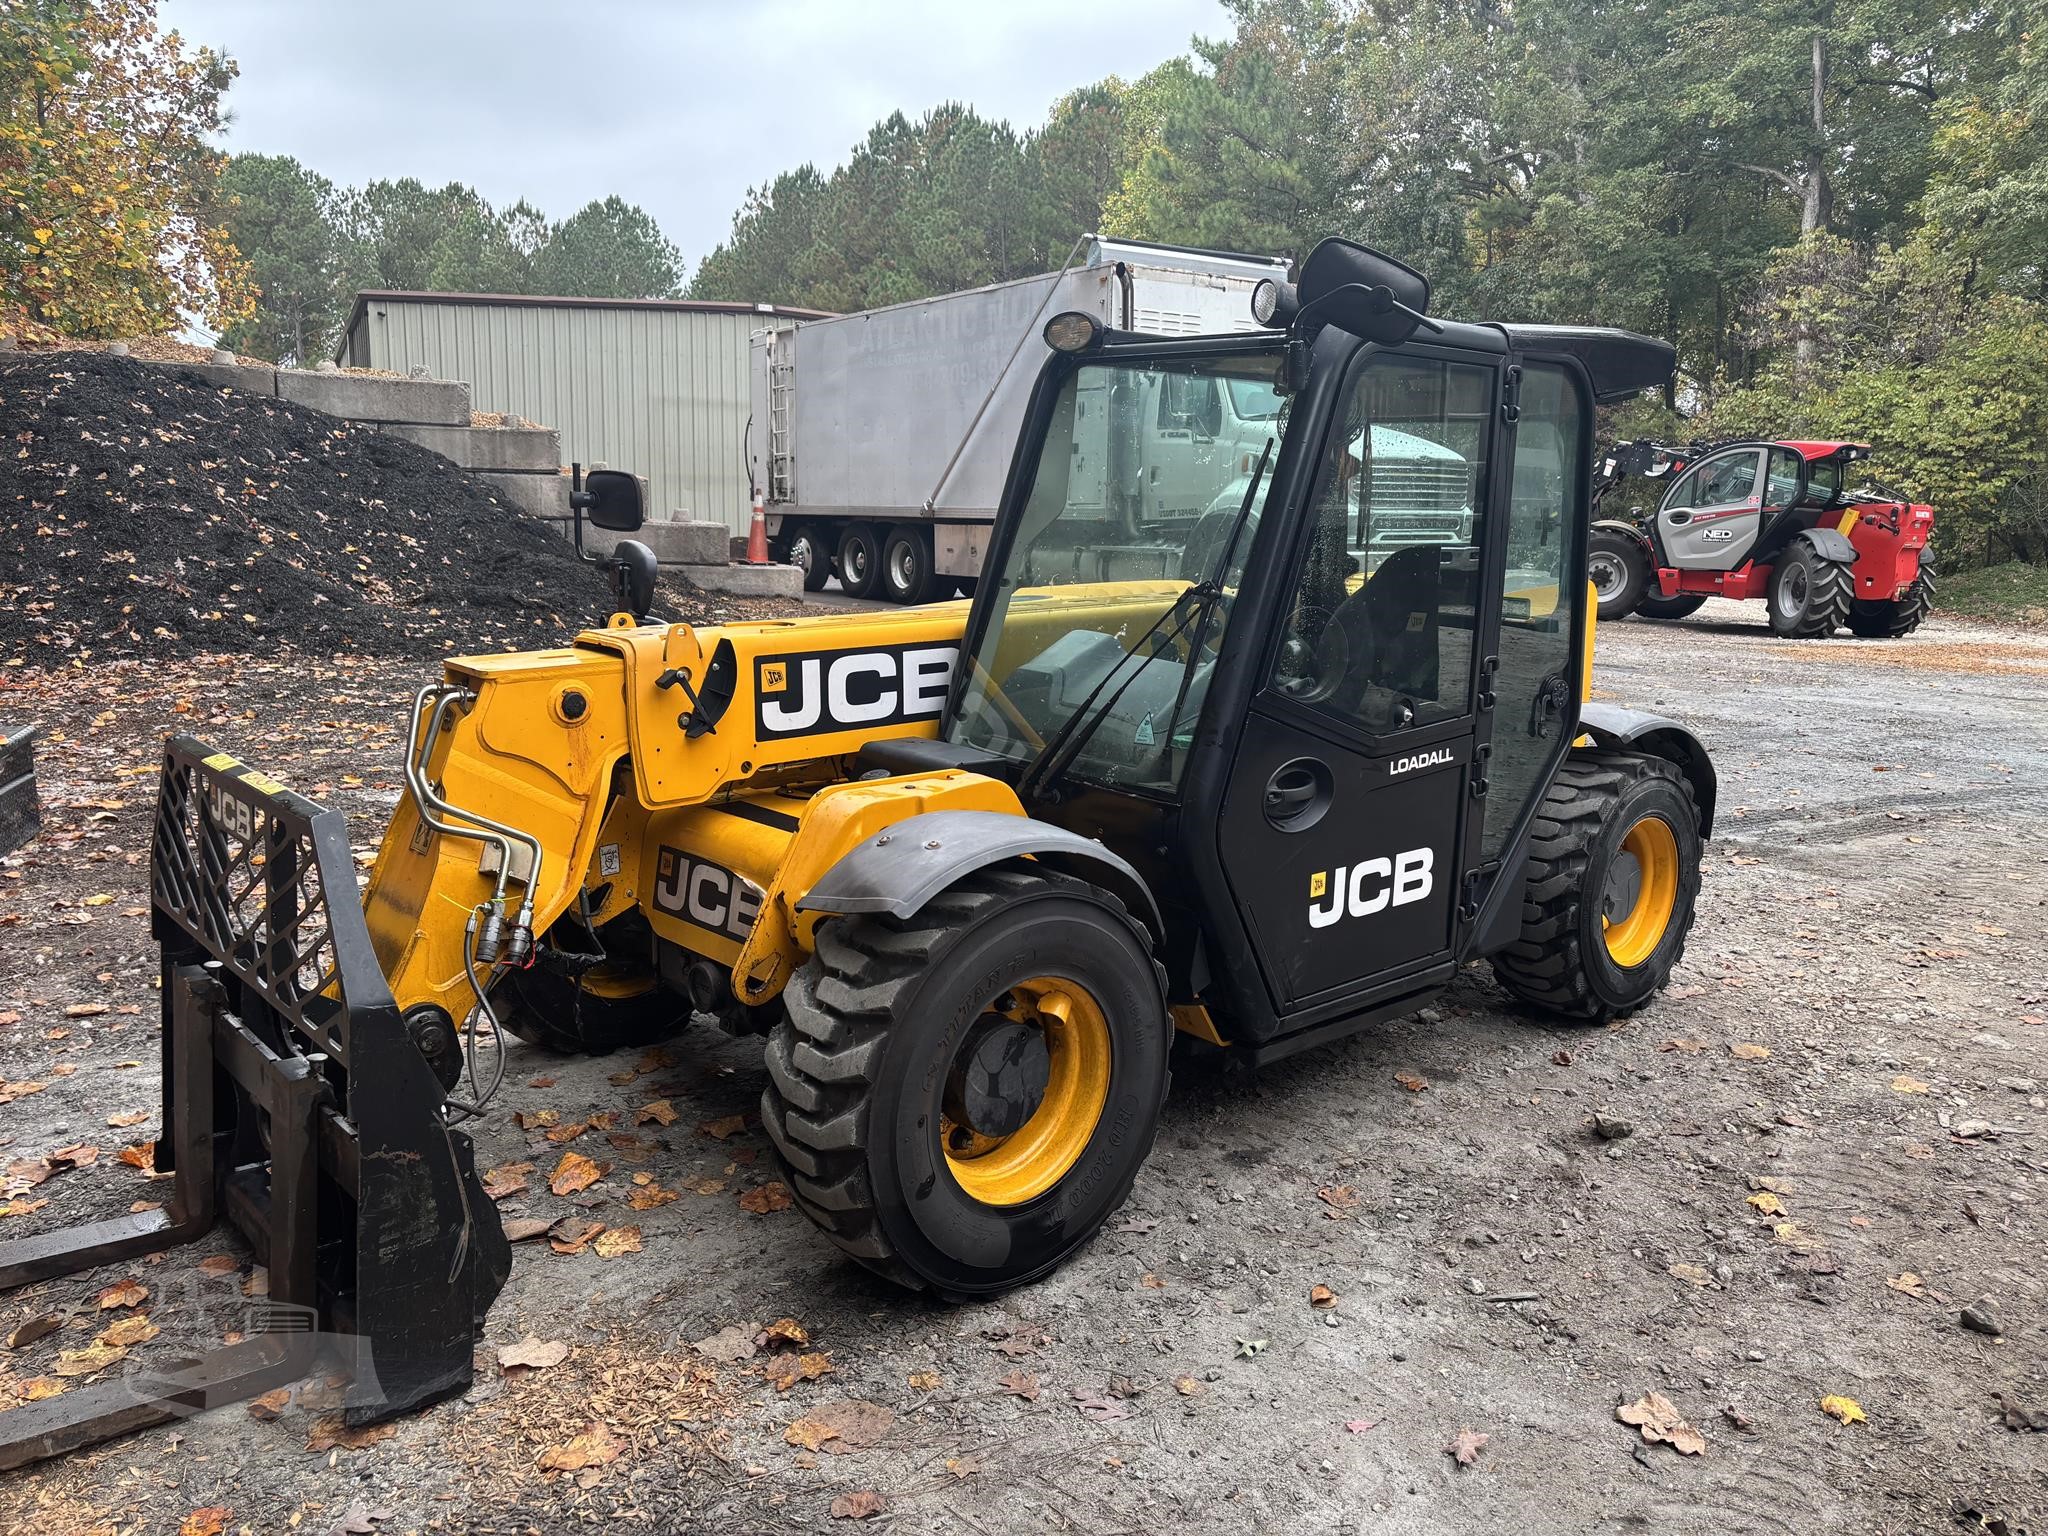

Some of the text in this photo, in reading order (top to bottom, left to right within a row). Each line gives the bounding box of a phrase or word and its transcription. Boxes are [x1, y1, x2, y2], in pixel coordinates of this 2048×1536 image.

[1703, 529, 1732, 538] NED
[761, 647, 960, 731] JCB
[1390, 748, 1454, 775] LOADALL
[211, 786, 251, 840] JCB
[658, 857, 762, 939] JCB
[1309, 847, 1434, 929] JCB
